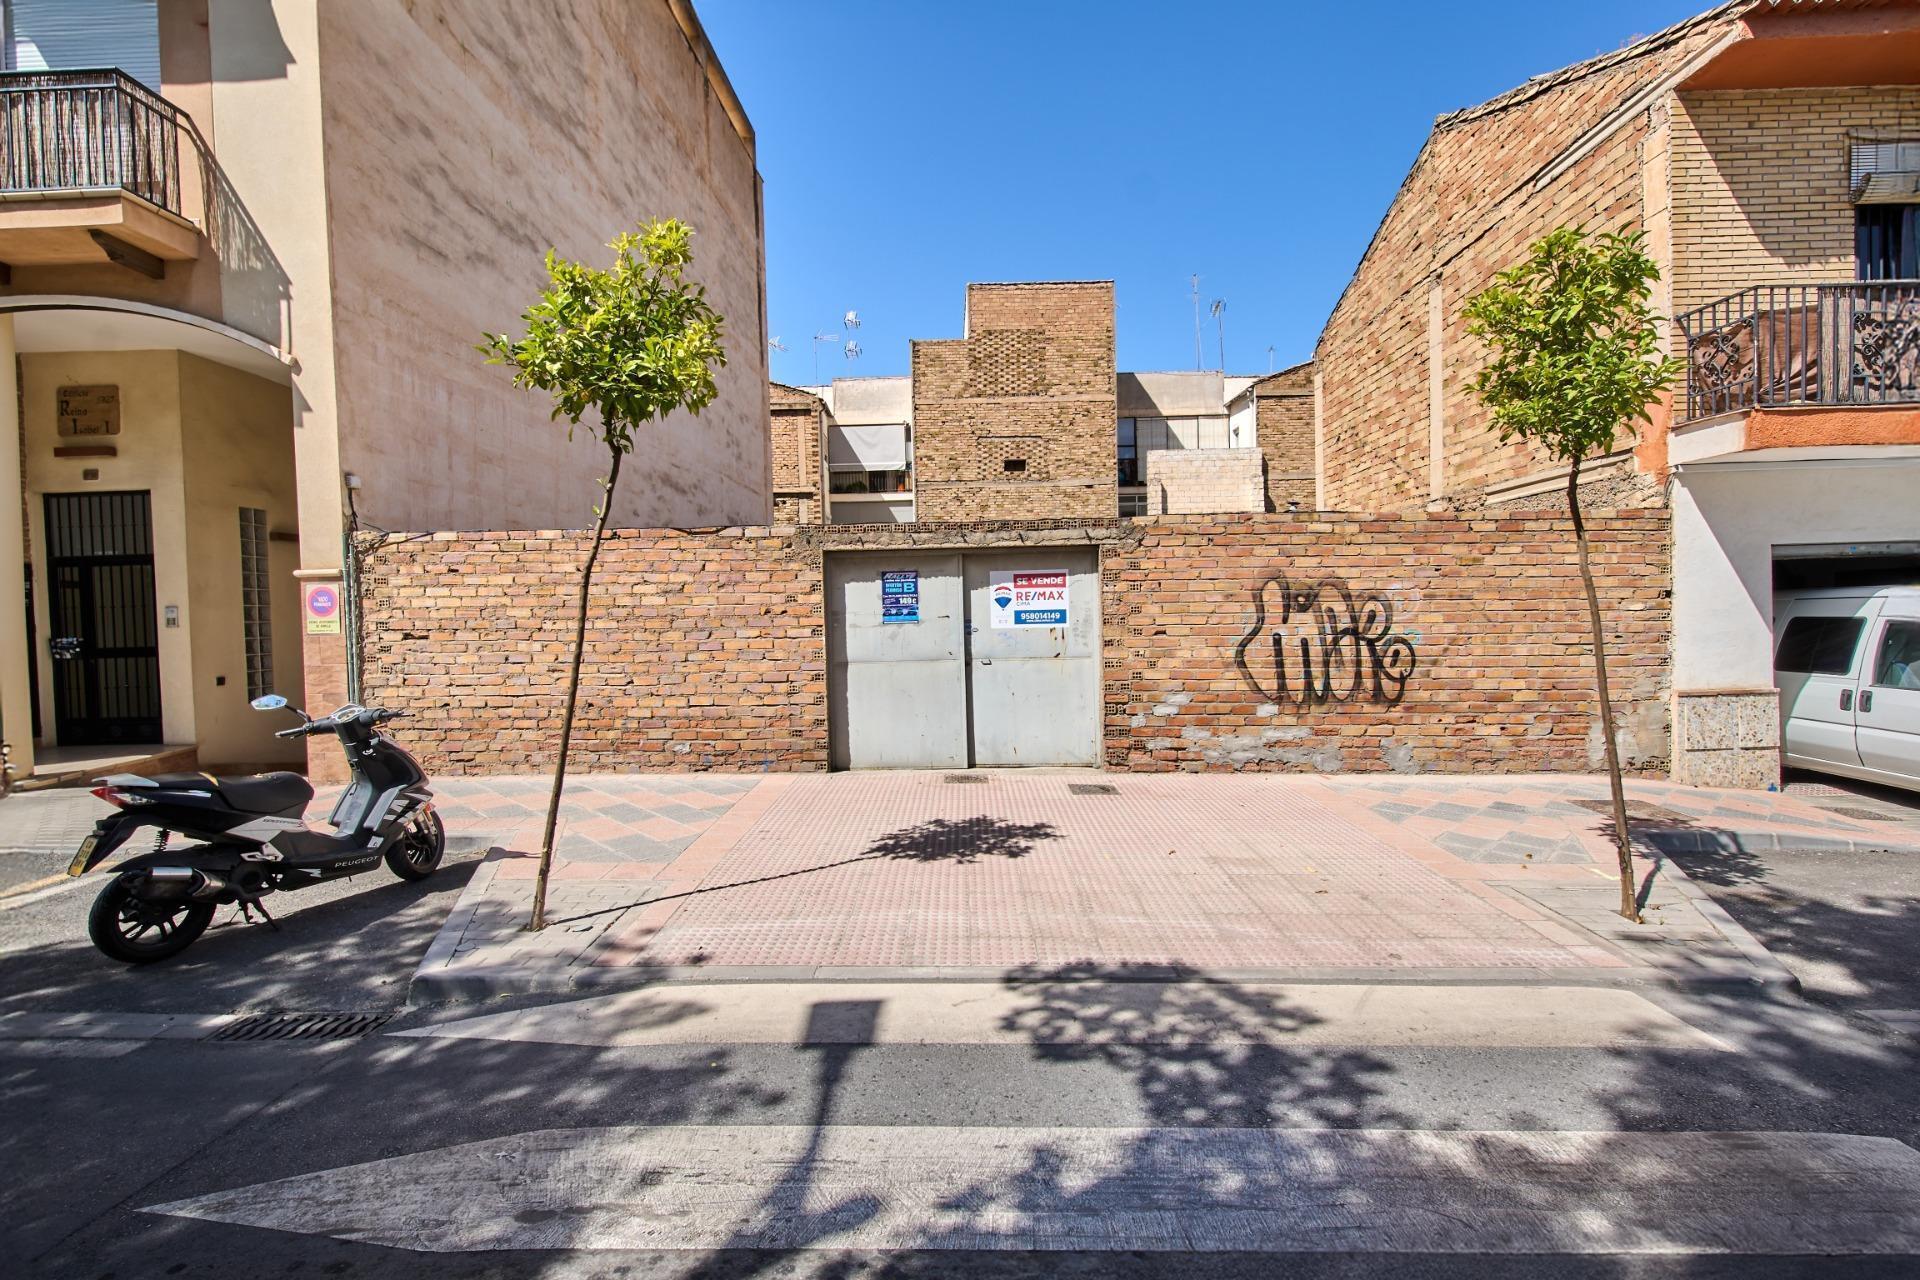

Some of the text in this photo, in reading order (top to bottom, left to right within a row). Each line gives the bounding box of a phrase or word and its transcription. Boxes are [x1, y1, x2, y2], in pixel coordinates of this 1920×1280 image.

[1016, 576, 1064, 585] SE VENDE
[1016, 590, 1064, 601] RE/MAX
[1020, 612, 1061, 620] 958014149
[334, 855, 379, 869] PEUGEOT
